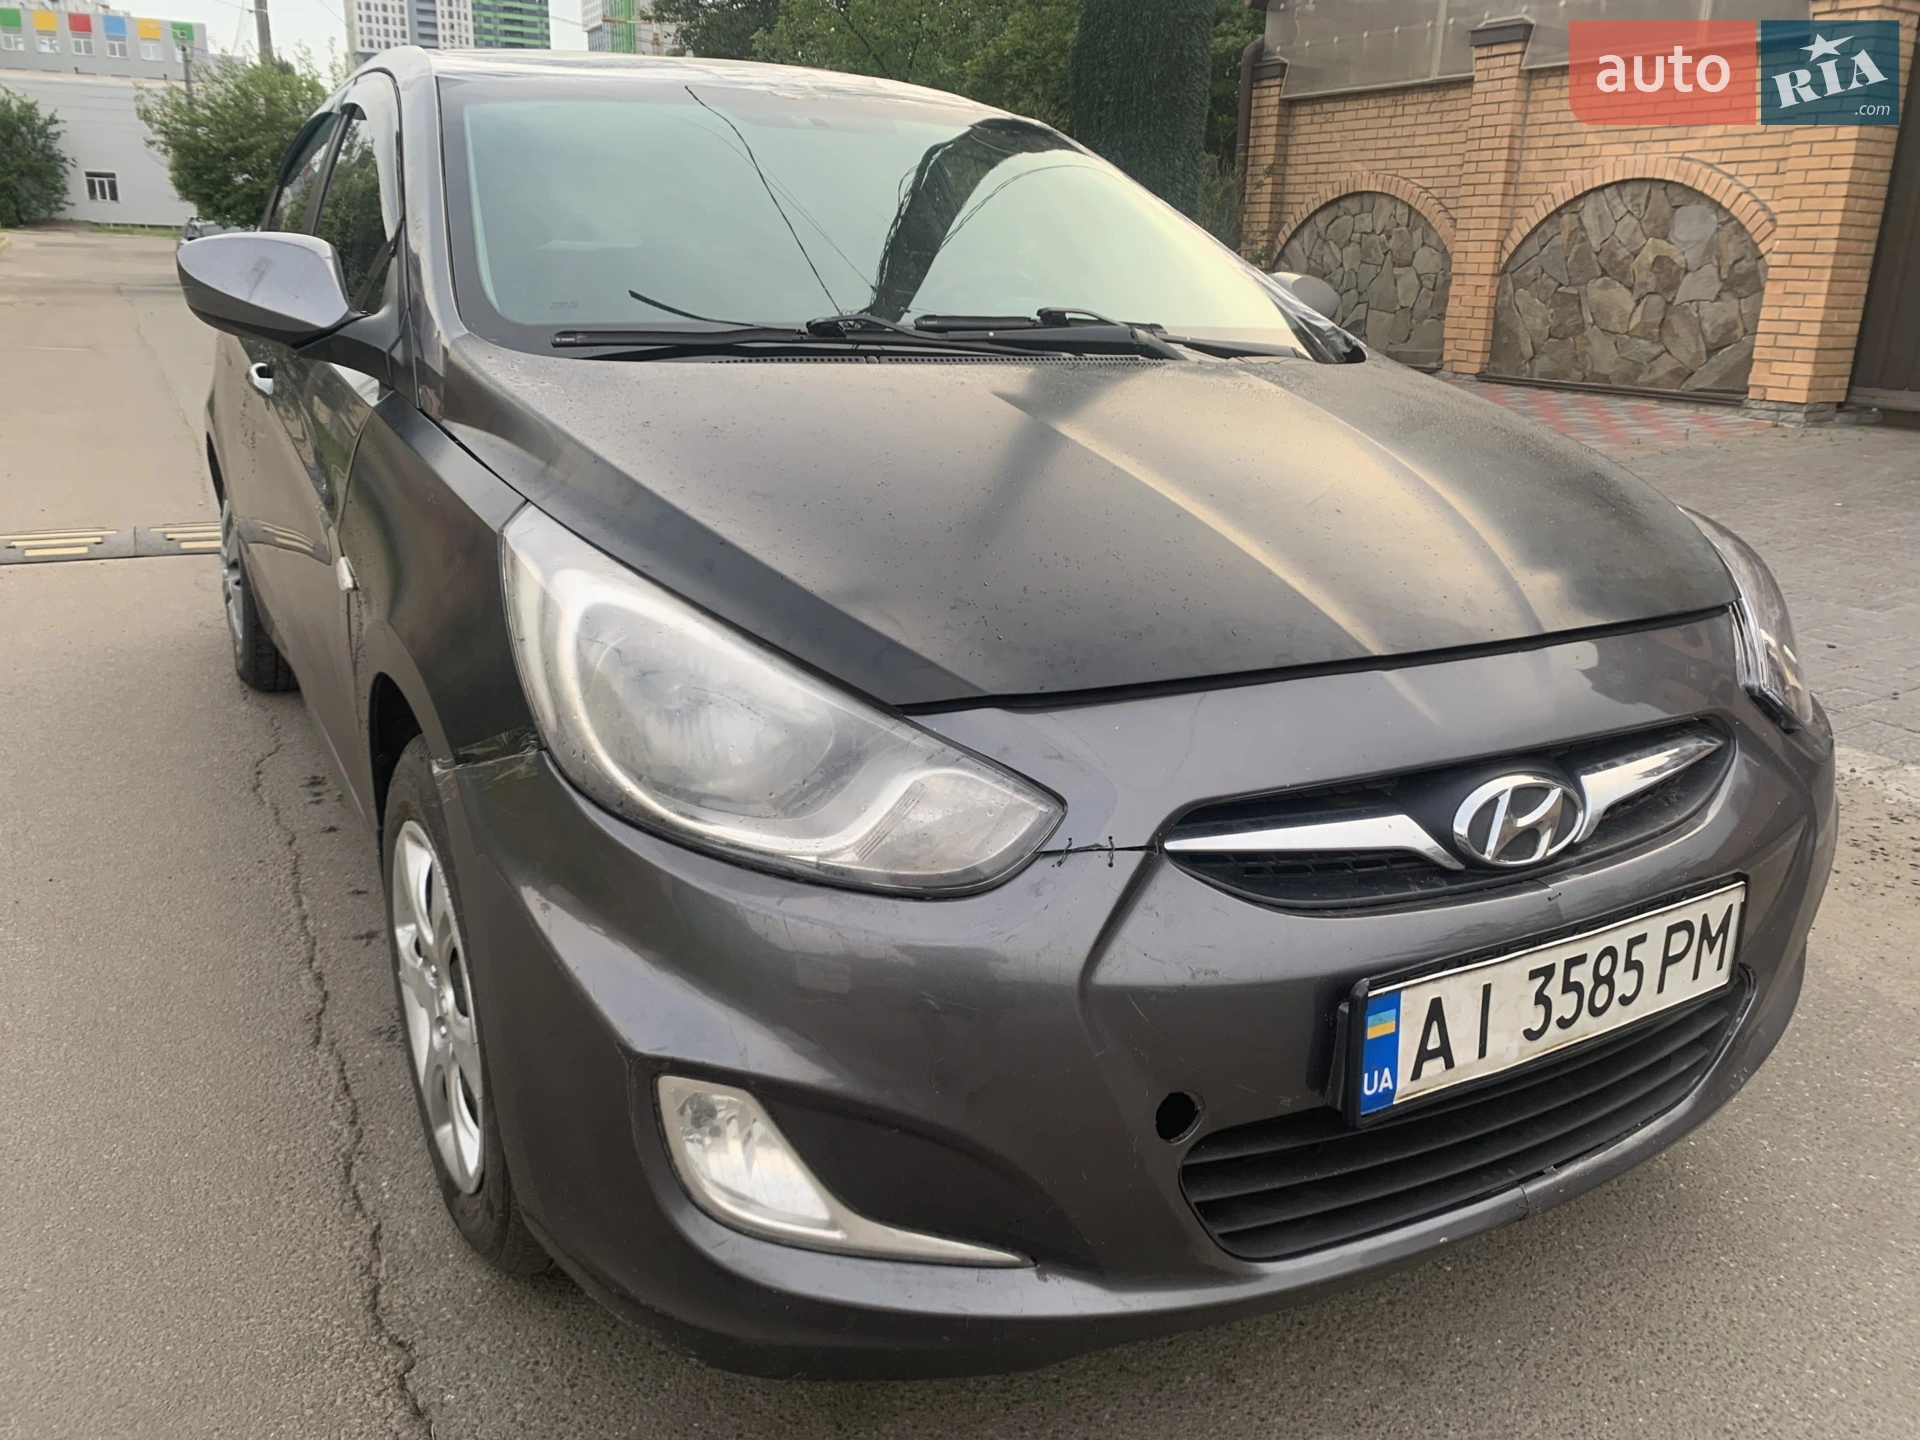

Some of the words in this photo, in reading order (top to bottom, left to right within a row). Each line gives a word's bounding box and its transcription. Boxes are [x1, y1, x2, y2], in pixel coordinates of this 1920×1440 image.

[1410, 983, 1492, 1081] AI
[1522, 932, 1648, 1041] 3585
[1656, 903, 1733, 994] PM
[1363, 1067, 1394, 1096] UA
